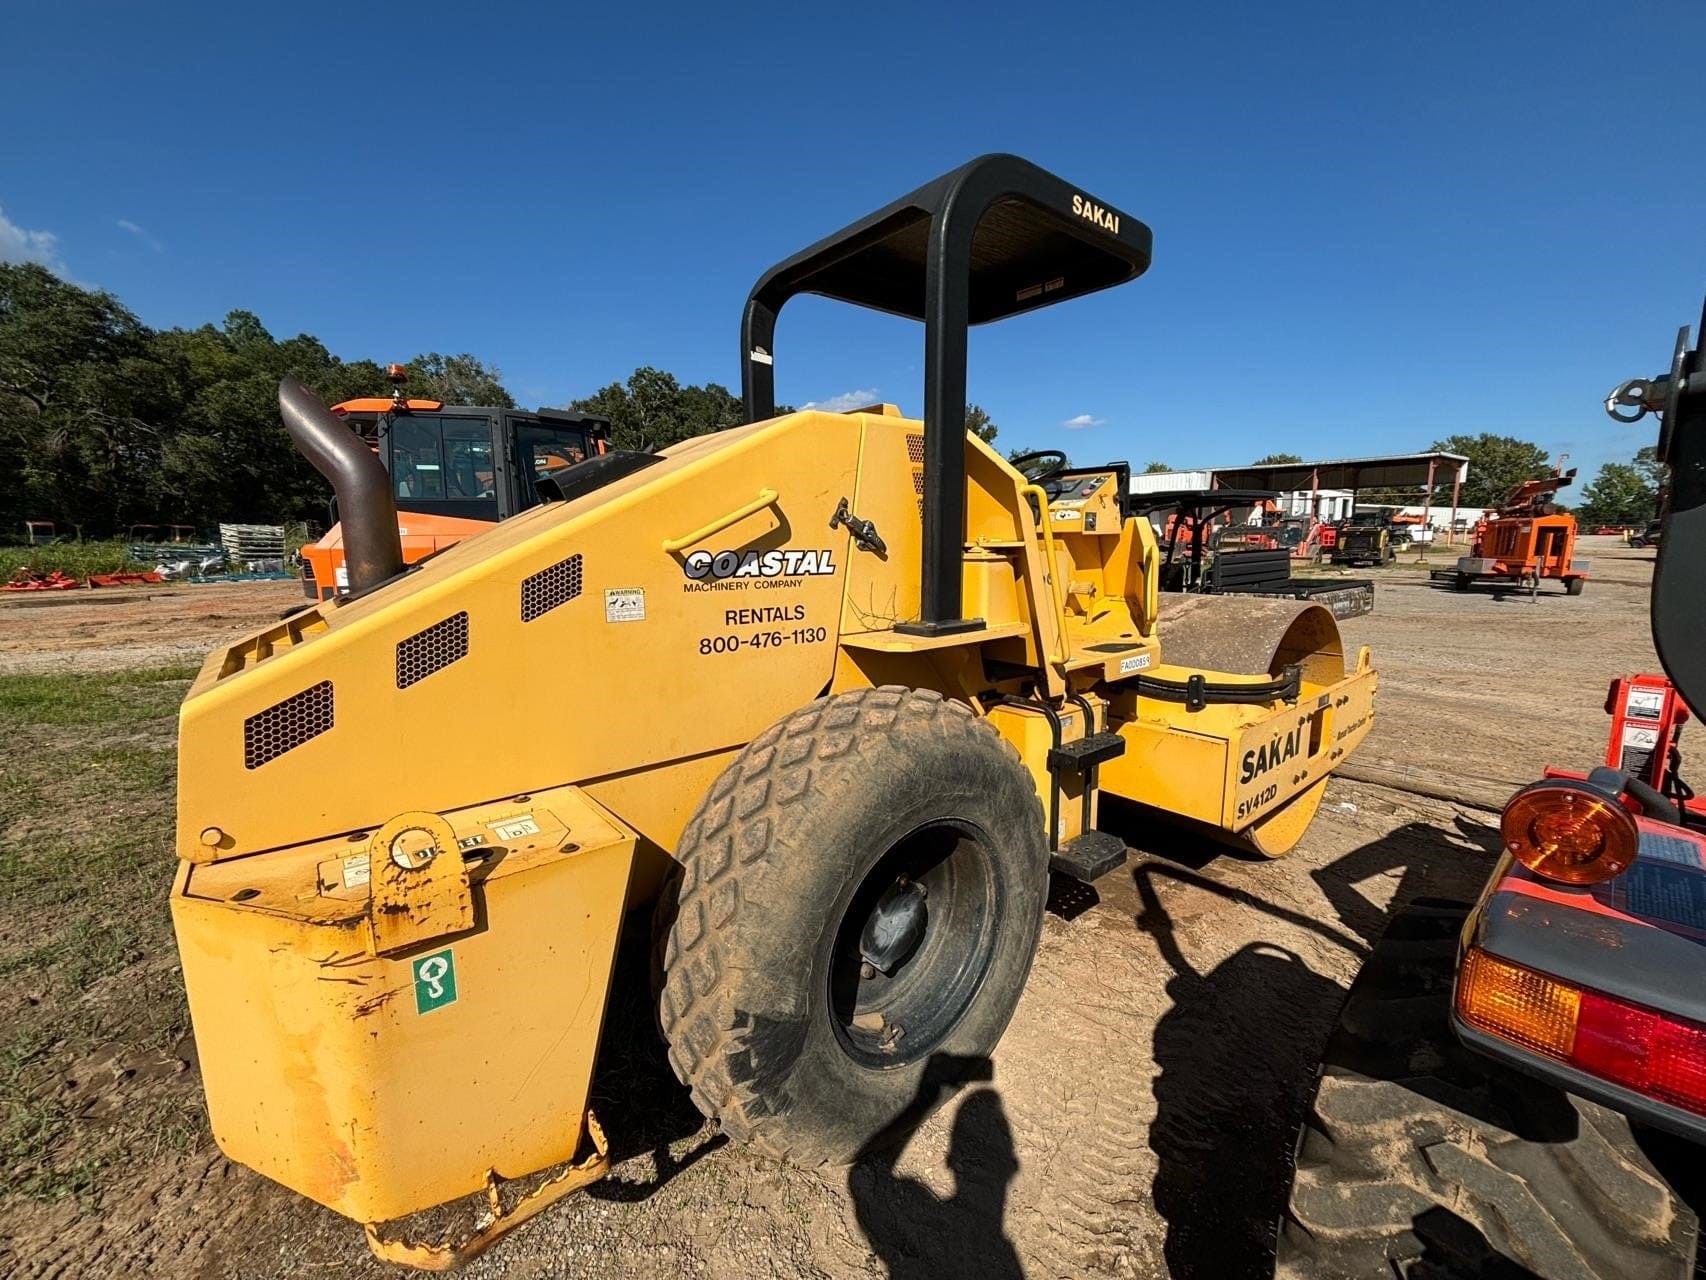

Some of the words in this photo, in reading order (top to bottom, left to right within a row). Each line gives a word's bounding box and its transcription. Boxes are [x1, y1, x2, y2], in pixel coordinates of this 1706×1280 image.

[1072, 194, 1120, 235] SAKAI
[683, 550, 836, 580] COASTAL
[683, 581, 750, 593] MACHINERY
[754, 579, 803, 590] COMPANY
[725, 604, 805, 626] RENTALS
[699, 627, 827, 655] 800-476-1130
[1240, 726, 1302, 785] SAKAI
[1237, 784, 1278, 820] SV412D
